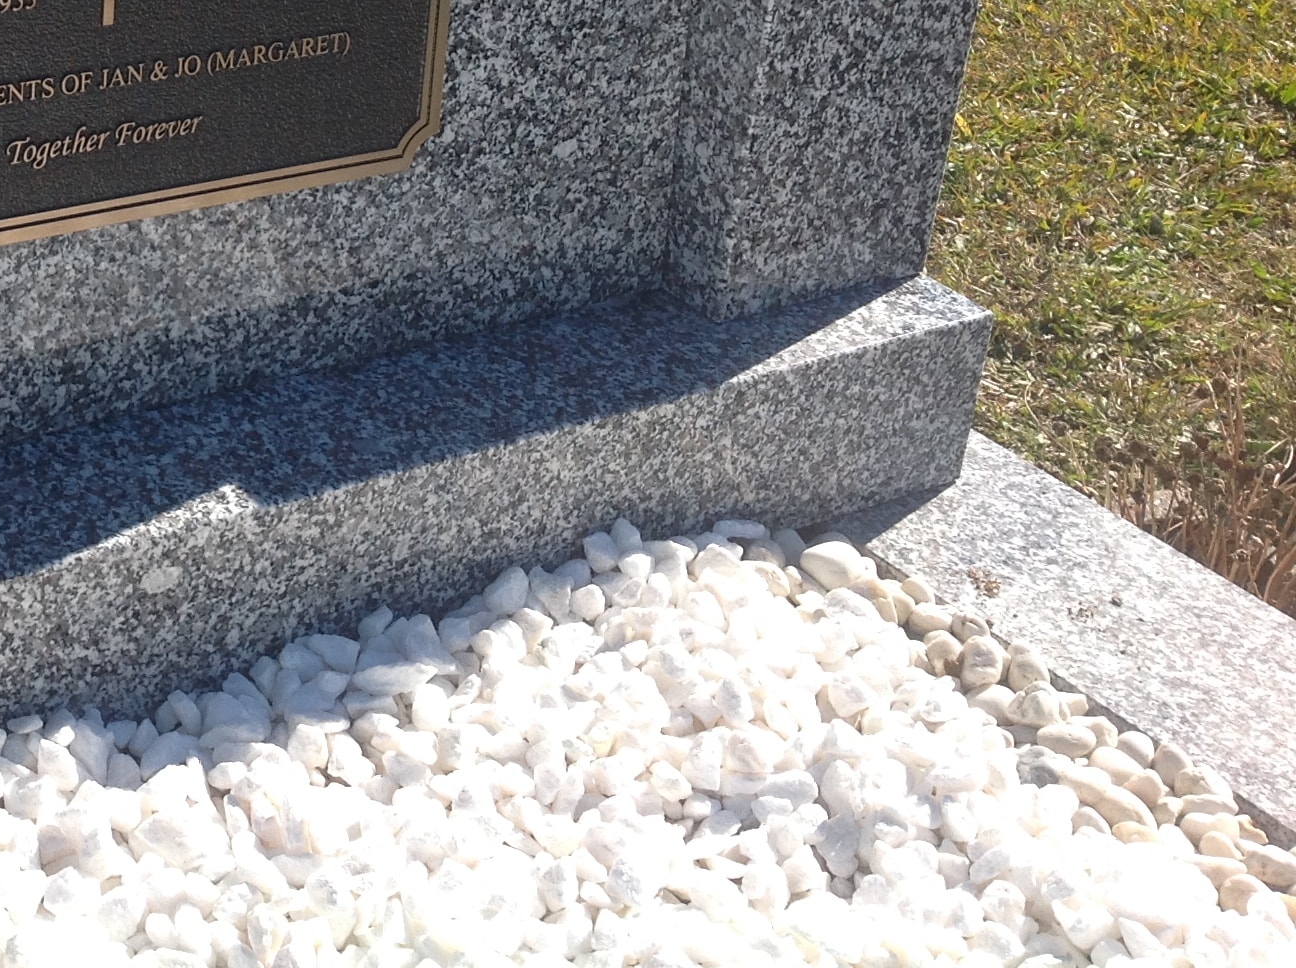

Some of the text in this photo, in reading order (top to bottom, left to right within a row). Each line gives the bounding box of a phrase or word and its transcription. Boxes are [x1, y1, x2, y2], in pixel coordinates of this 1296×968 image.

[61, 71, 93, 98] OF
[97, 64, 144, 93] JAN
[149, 62, 169, 83] &
[174, 54, 202, 81] JO
[207, 31, 351, 77] (MARGARET)
[5, 111, 203, 170] Together Forever
